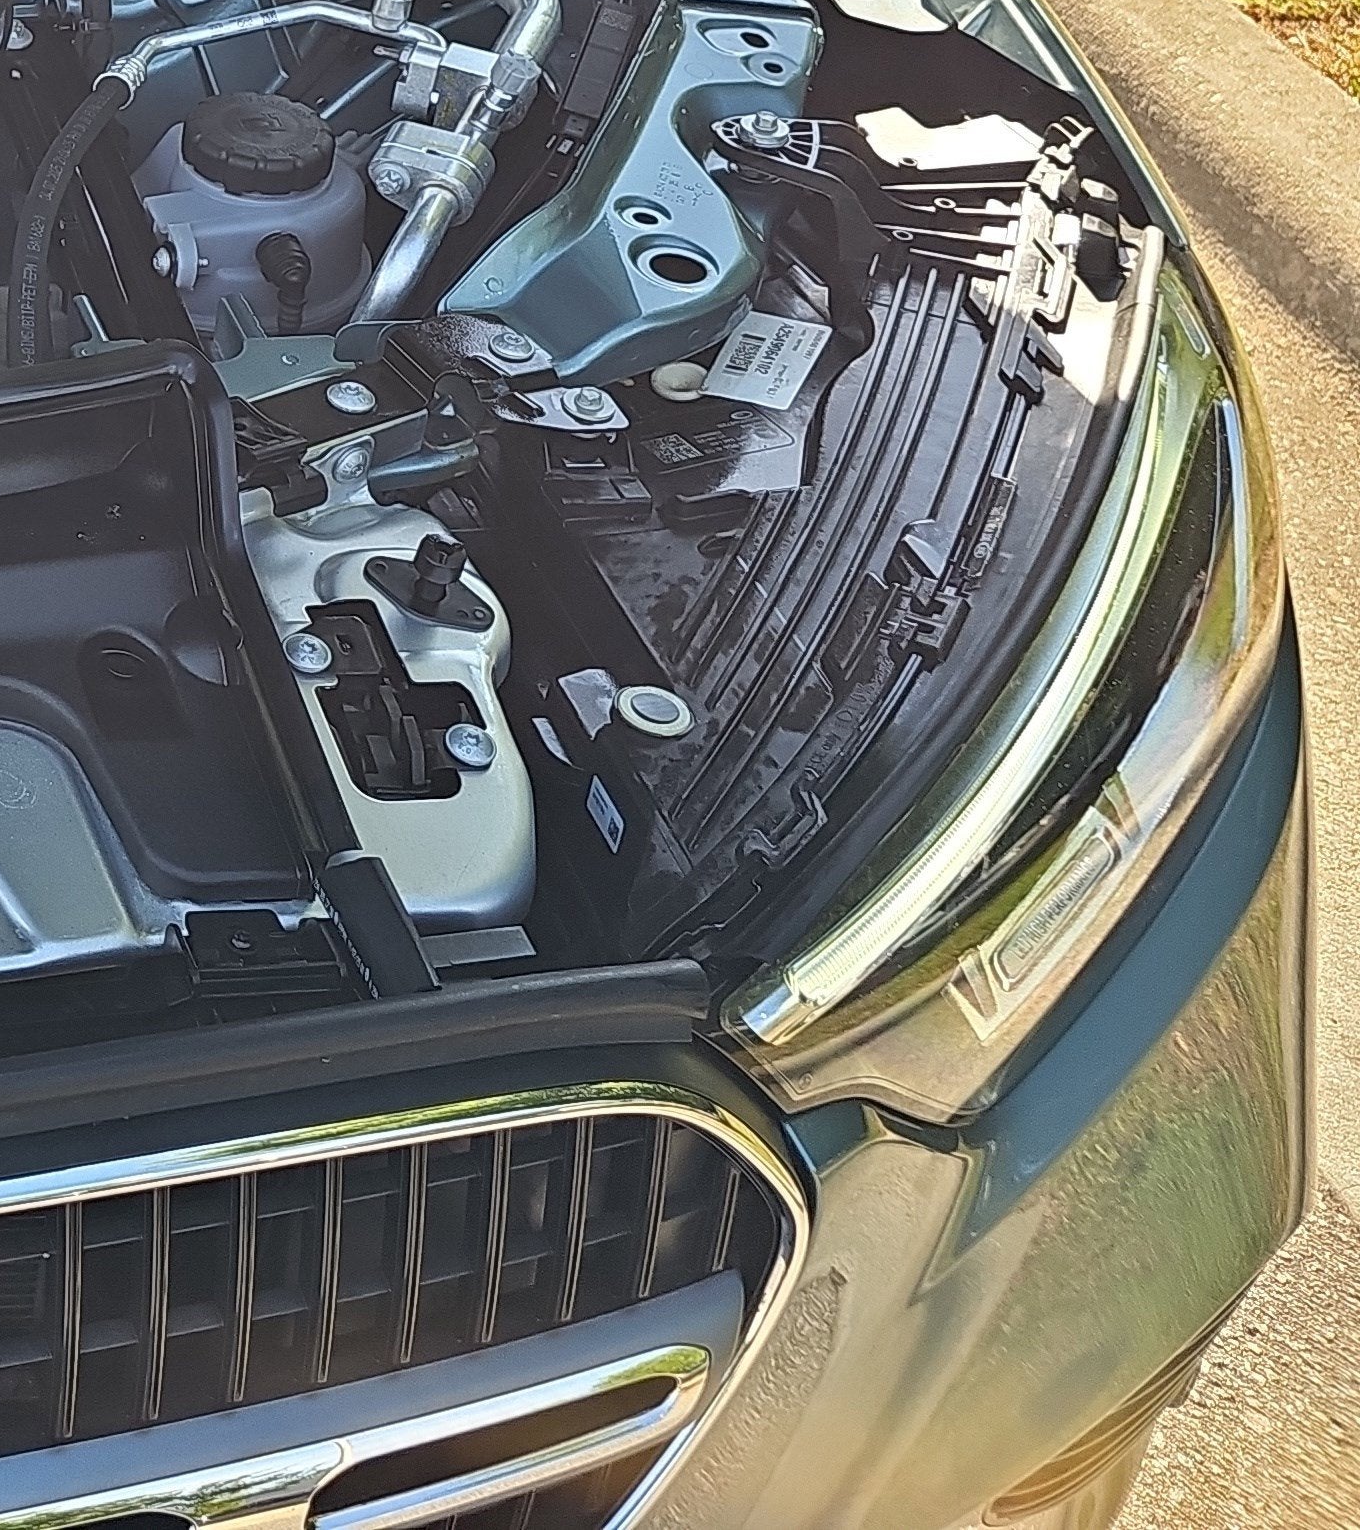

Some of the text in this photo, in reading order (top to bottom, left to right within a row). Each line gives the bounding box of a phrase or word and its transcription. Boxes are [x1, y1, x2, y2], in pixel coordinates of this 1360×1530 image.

[754, 322, 795, 376] A2549064102
[1012, 856, 1094, 960] LED HIGH PERFORMANCE
